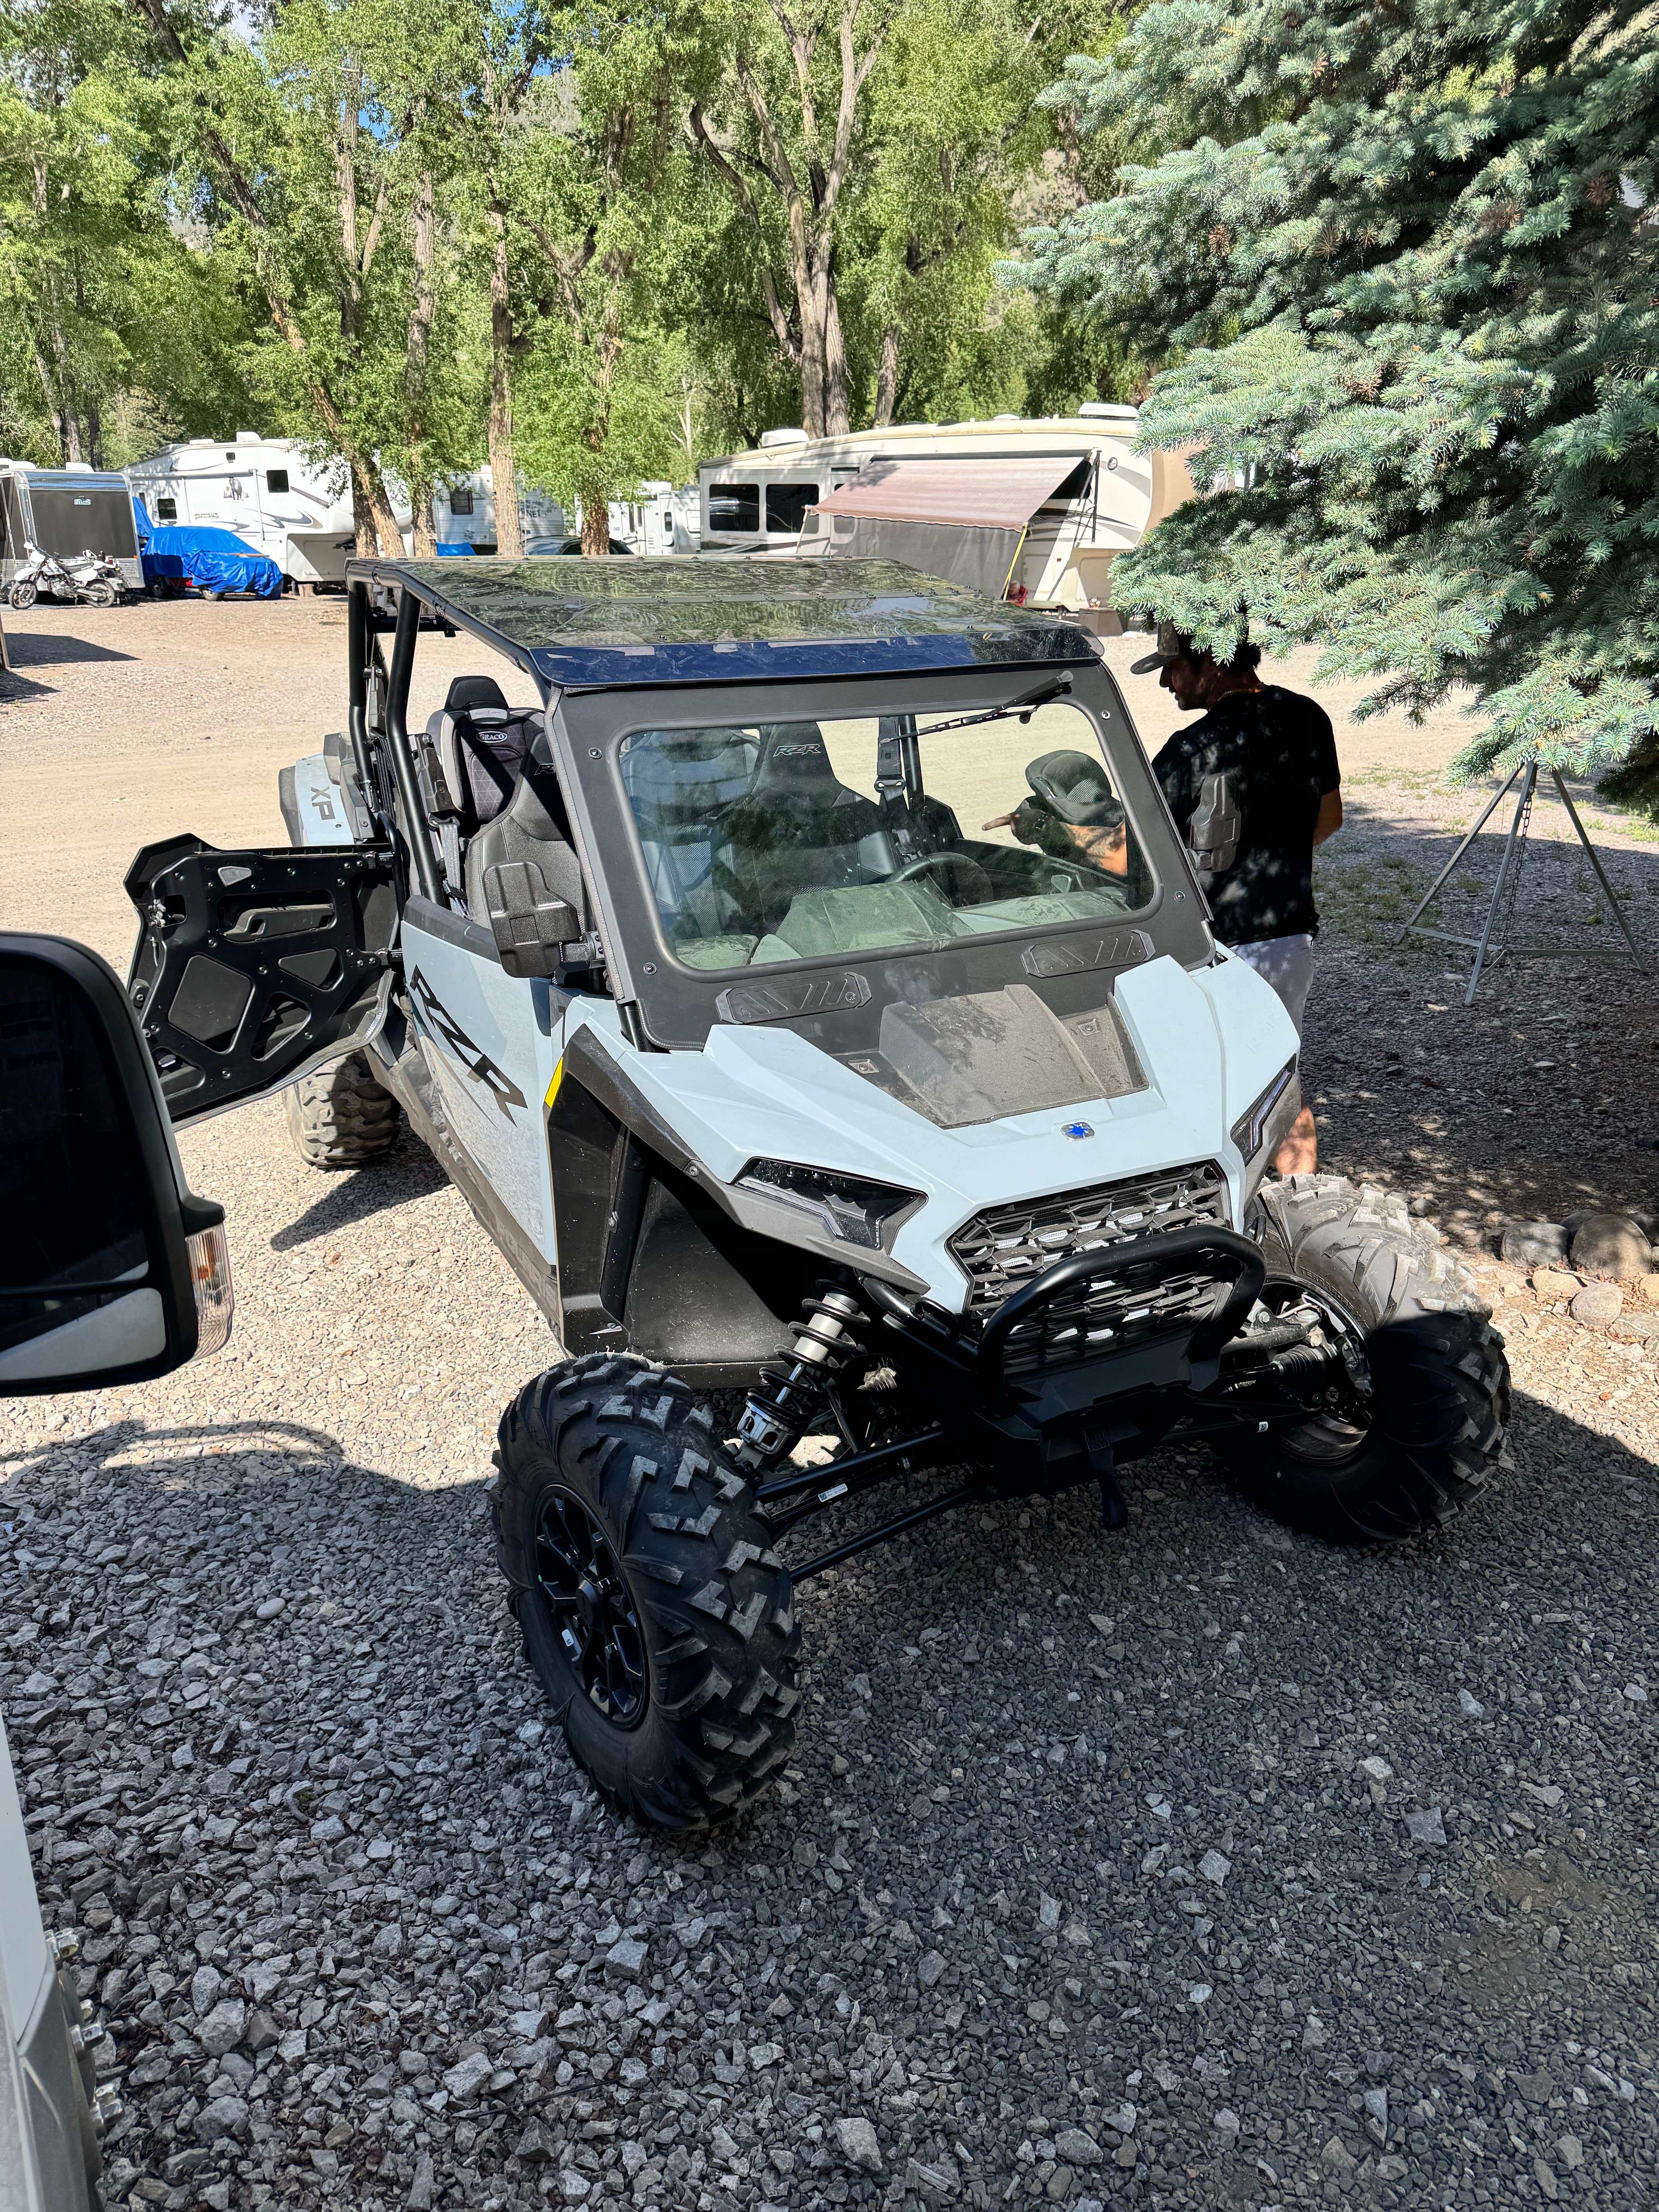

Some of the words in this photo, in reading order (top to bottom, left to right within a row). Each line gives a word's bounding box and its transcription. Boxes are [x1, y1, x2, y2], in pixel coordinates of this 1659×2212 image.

[773, 744, 821, 757] RZR
[311, 785, 335, 820] XP
[409, 964, 528, 1129] RZR
